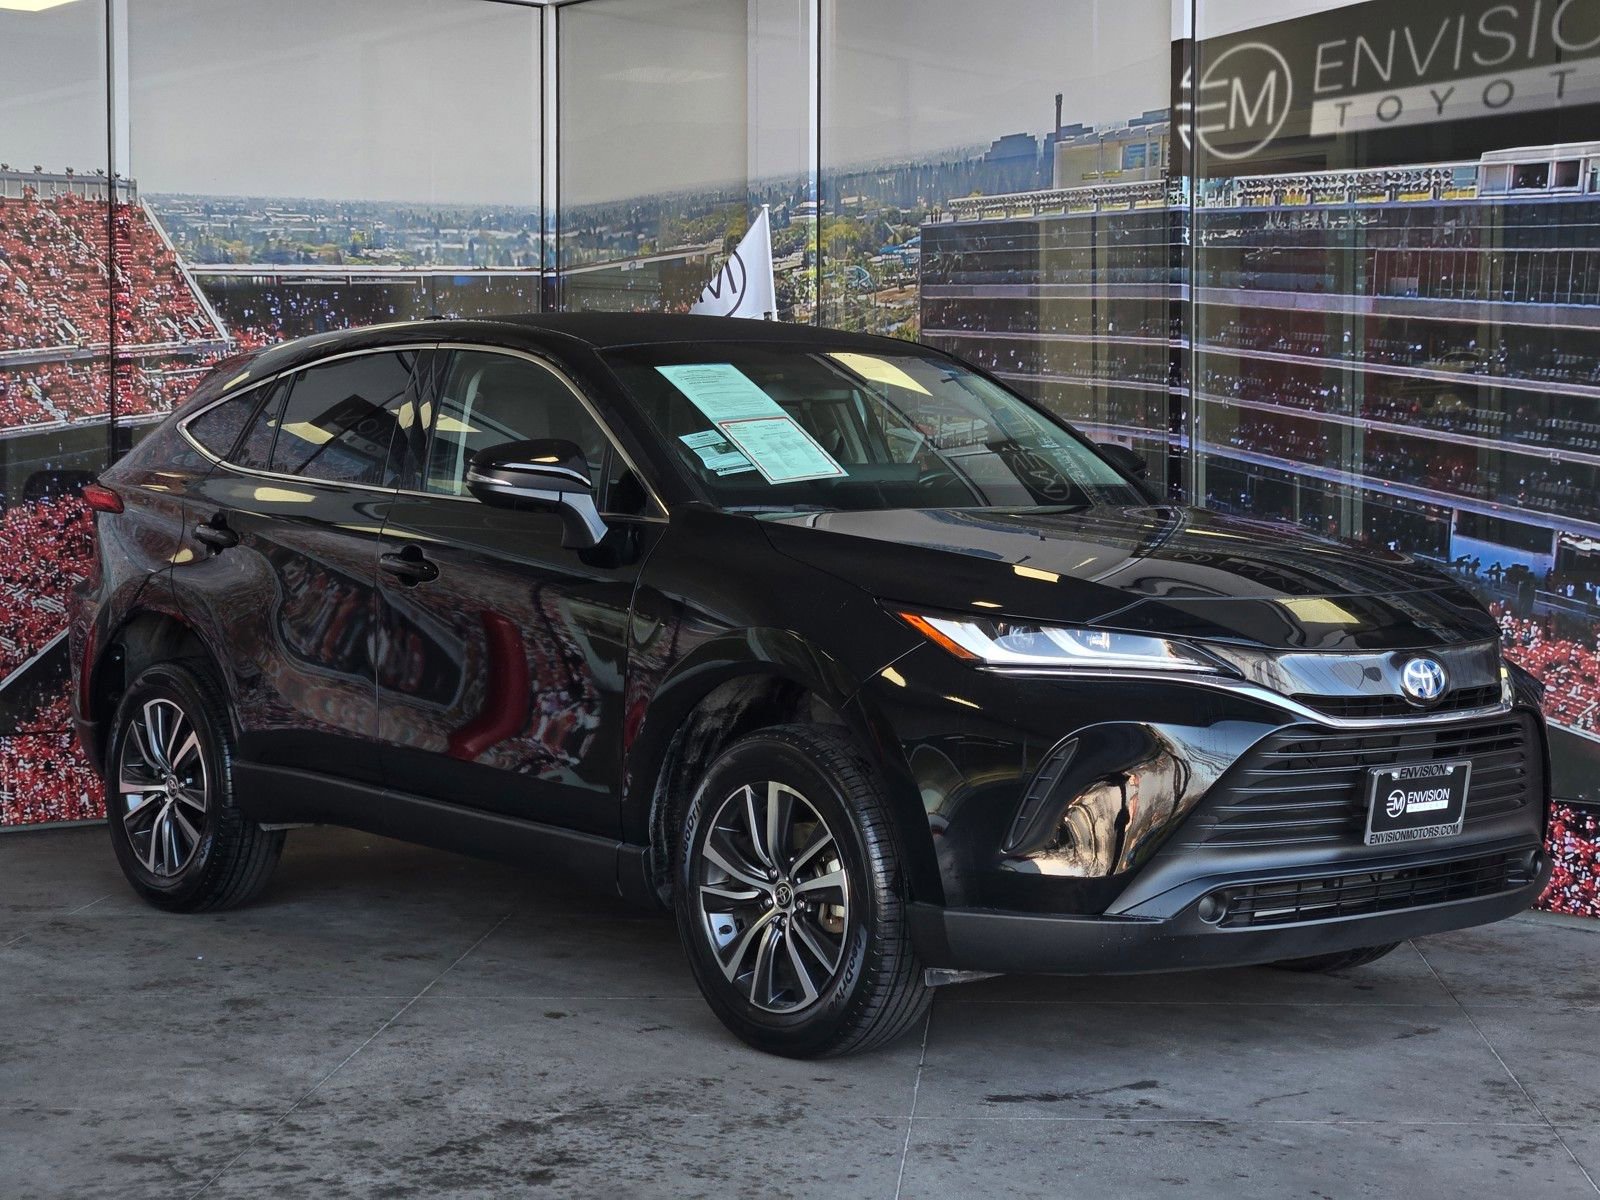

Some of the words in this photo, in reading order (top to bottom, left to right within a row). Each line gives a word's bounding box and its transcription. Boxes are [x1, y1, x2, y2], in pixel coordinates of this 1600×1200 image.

[1334, 69, 1577, 128] TOYOT
[1400, 764, 1447, 779] ENVISION
[1407, 788, 1450, 803] ENVISION
[1369, 824, 1459, 845] ENVISIONMOTORS.COM
